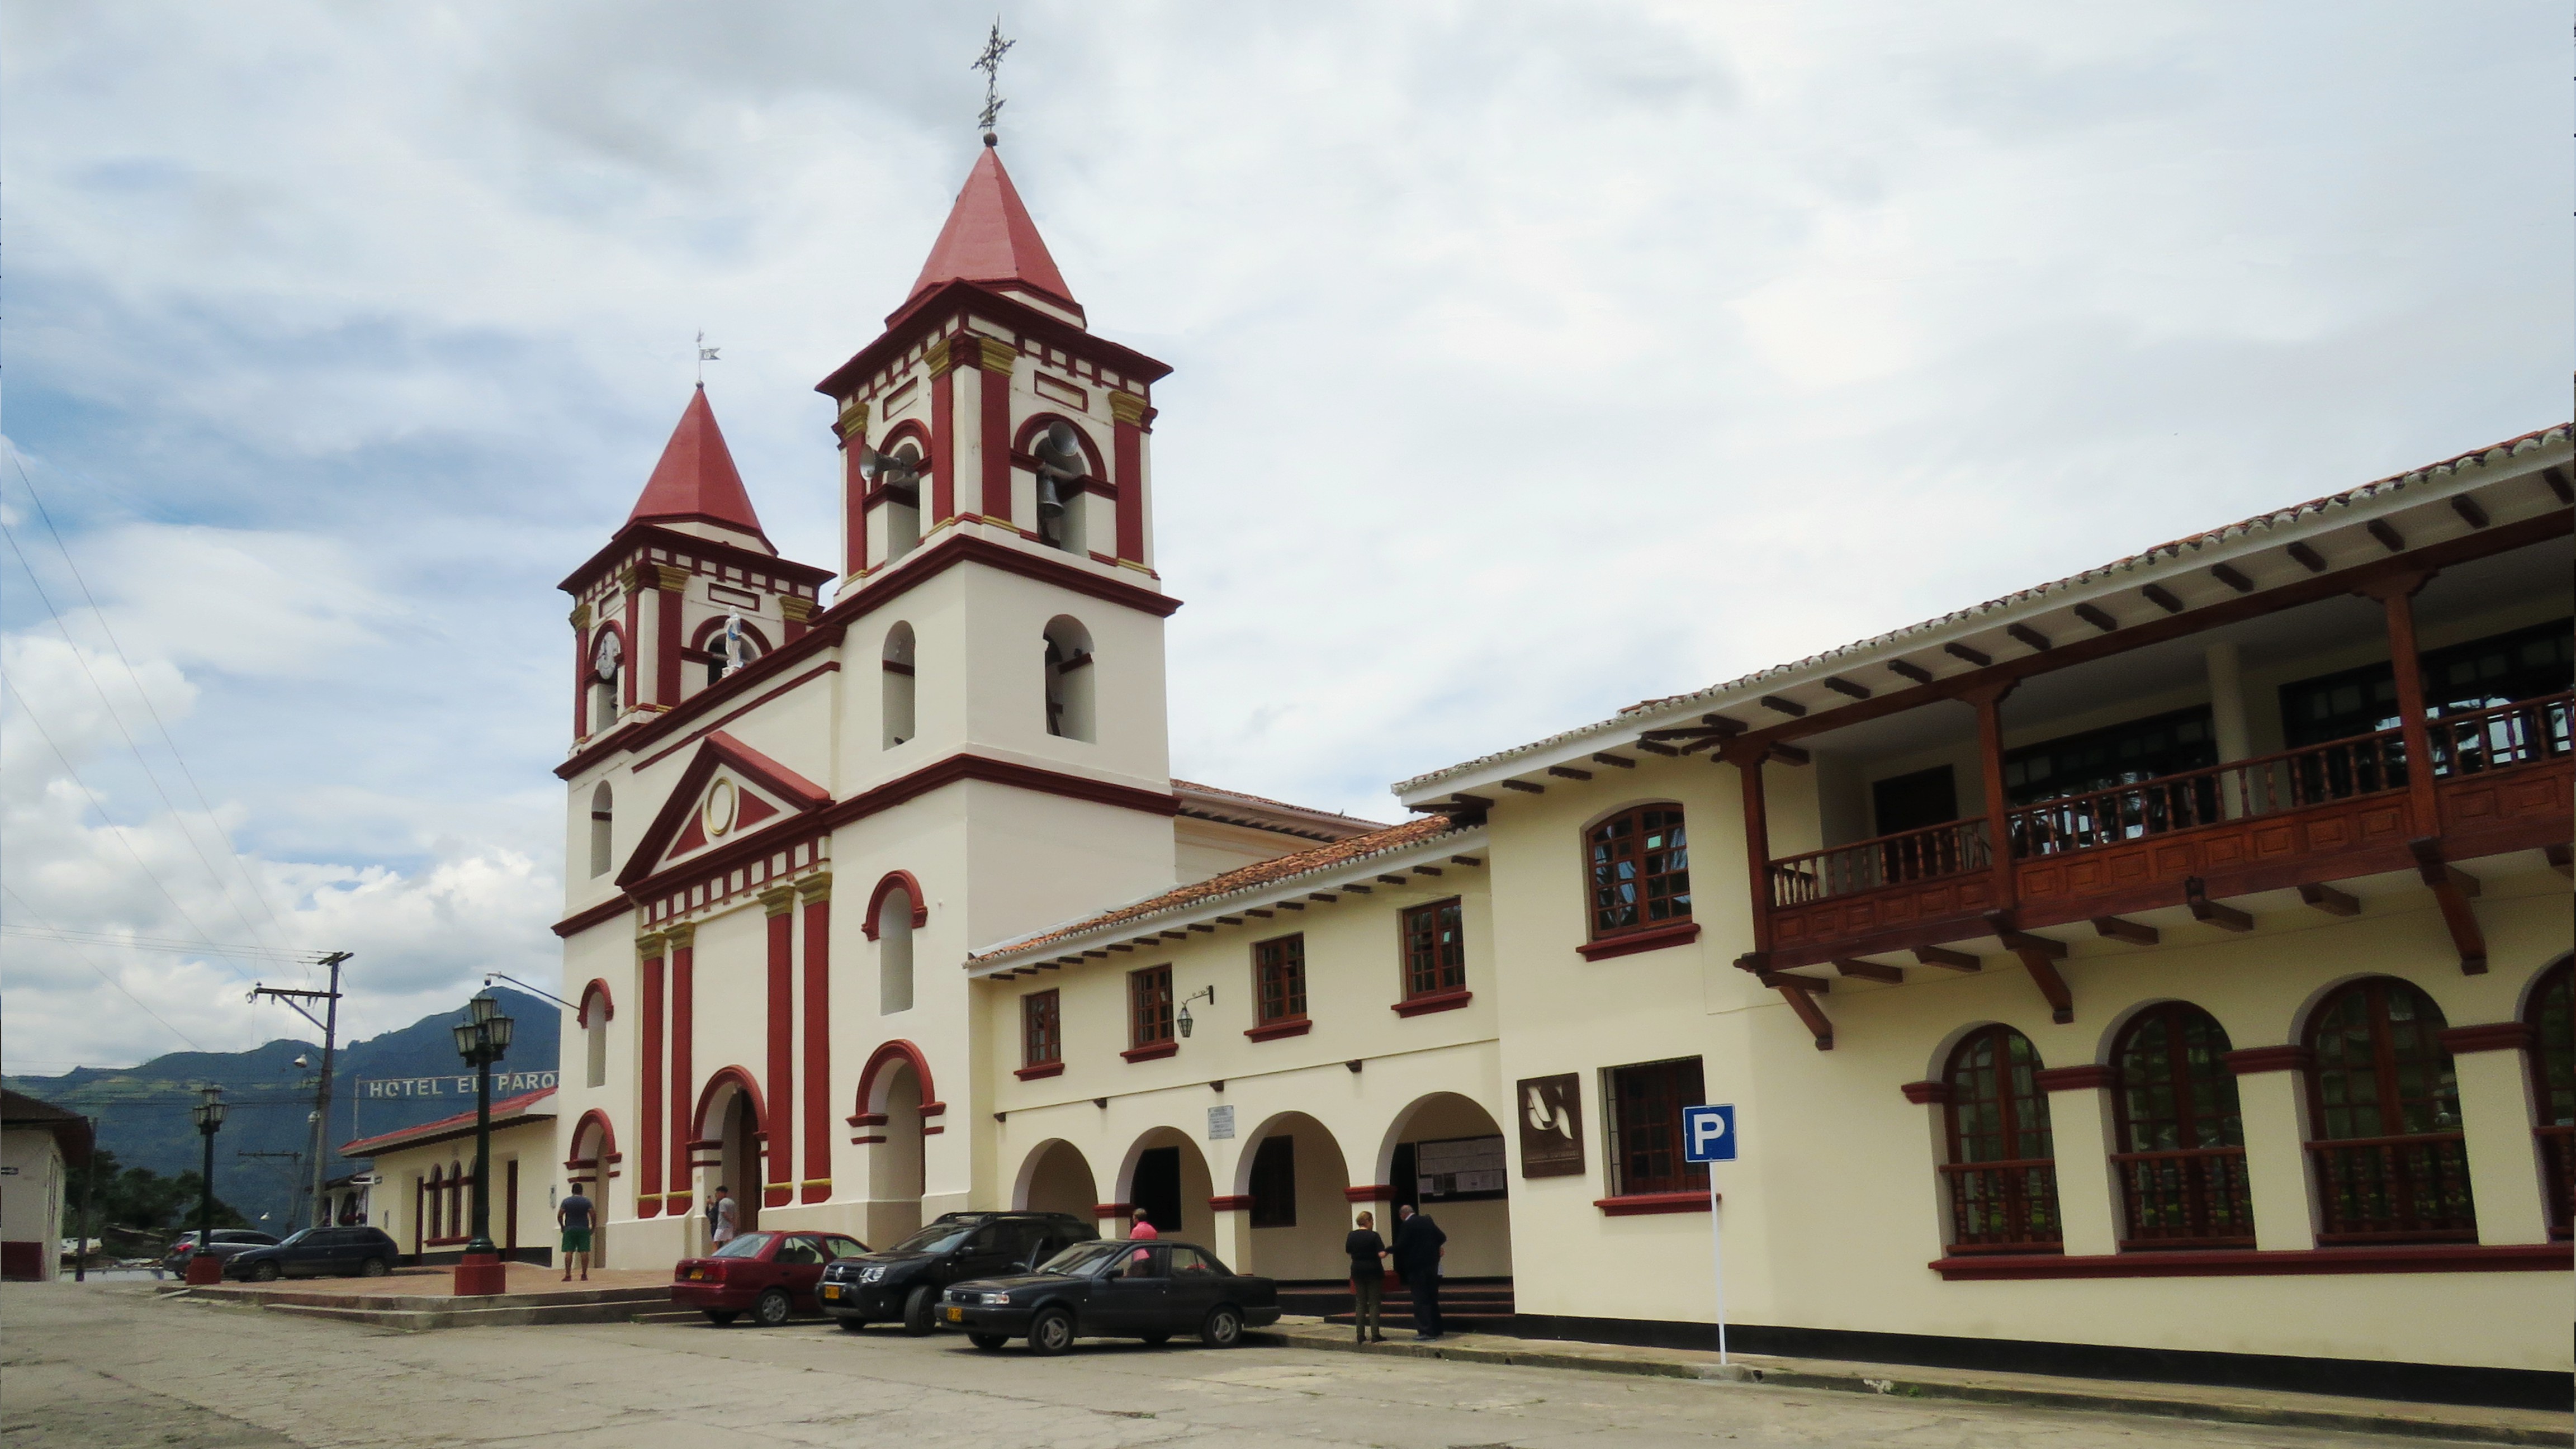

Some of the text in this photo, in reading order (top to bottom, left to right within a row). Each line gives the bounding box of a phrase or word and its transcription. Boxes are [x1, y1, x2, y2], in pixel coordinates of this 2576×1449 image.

[370, 1079, 443, 1097] HOTEL
[458, 1077, 479, 1093] EL
[1693, 1113, 1725, 1155] P
